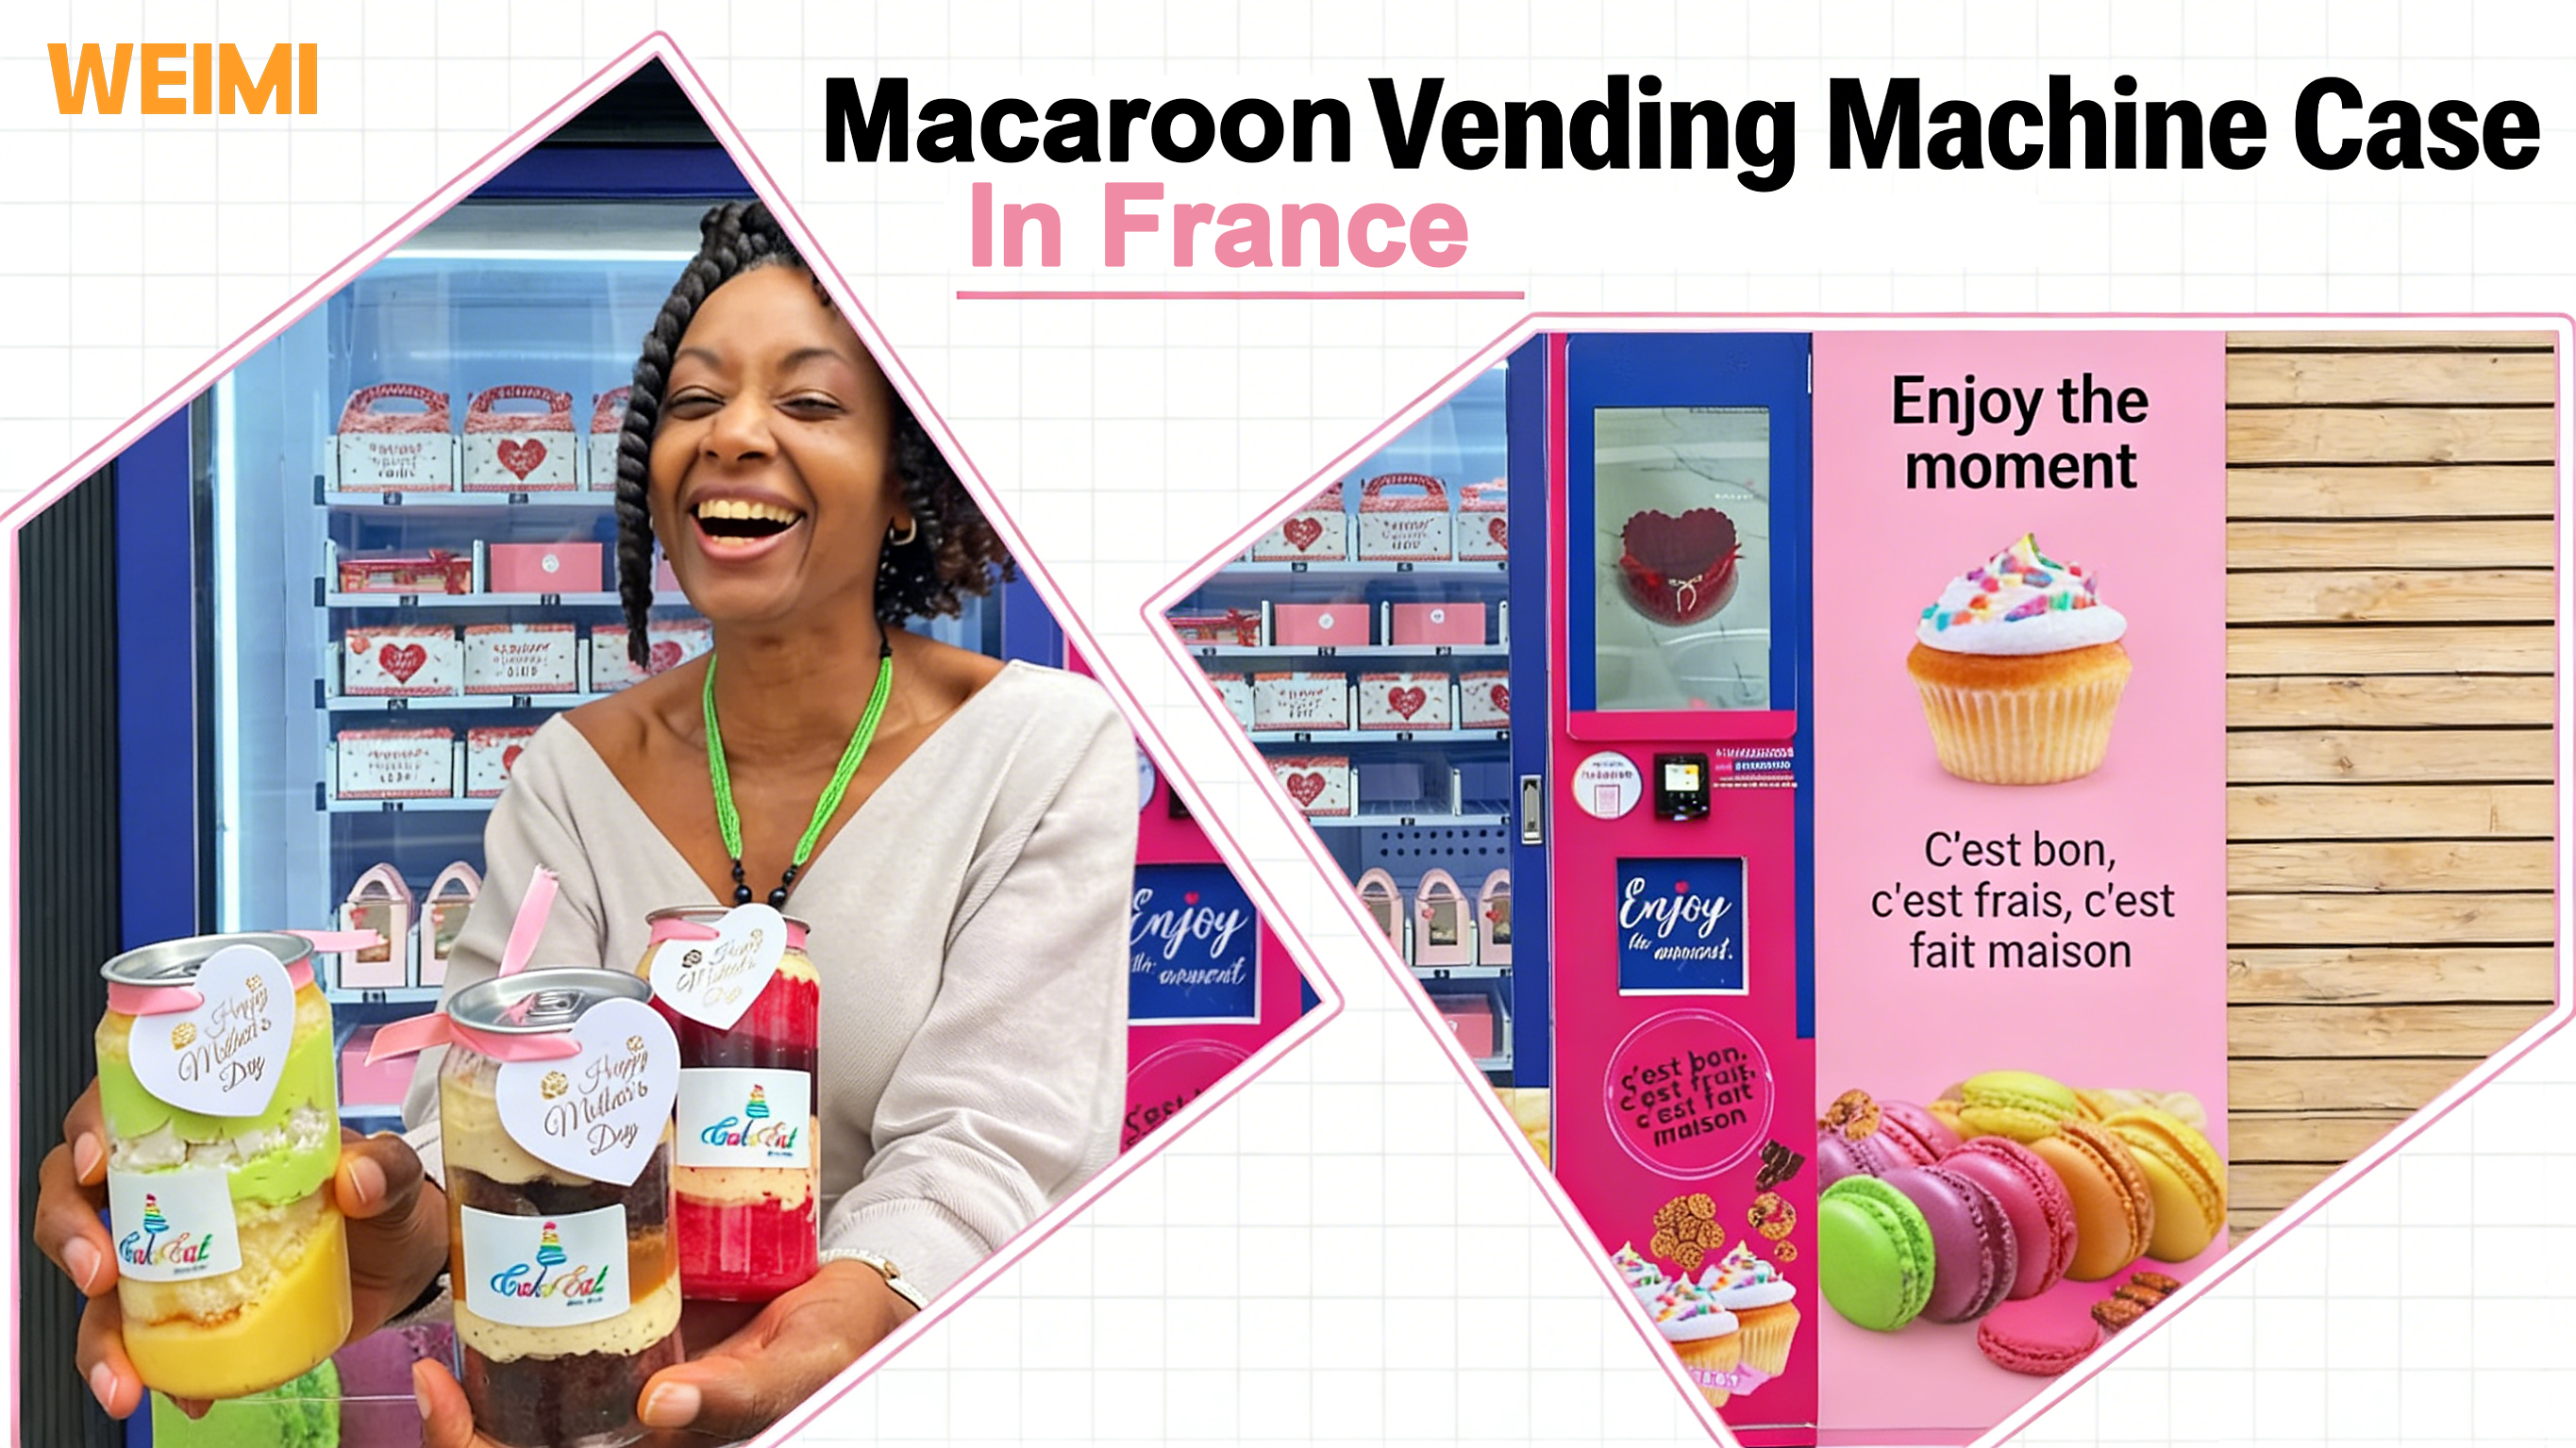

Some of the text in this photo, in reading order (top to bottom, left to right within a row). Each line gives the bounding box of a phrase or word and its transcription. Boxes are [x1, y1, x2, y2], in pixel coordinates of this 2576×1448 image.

[1893, 373, 2149, 437] Enjoy the
[1906, 443, 2138, 490] moment
[1925, 830, 2116, 873] C'est bon,
[1129, 888, 1249, 959] Enjoy
[1619, 877, 1732, 939] Enjoy
[1872, 880, 2175, 924] c'est frais, c'est
[1910, 931, 2131, 968] fait maison
